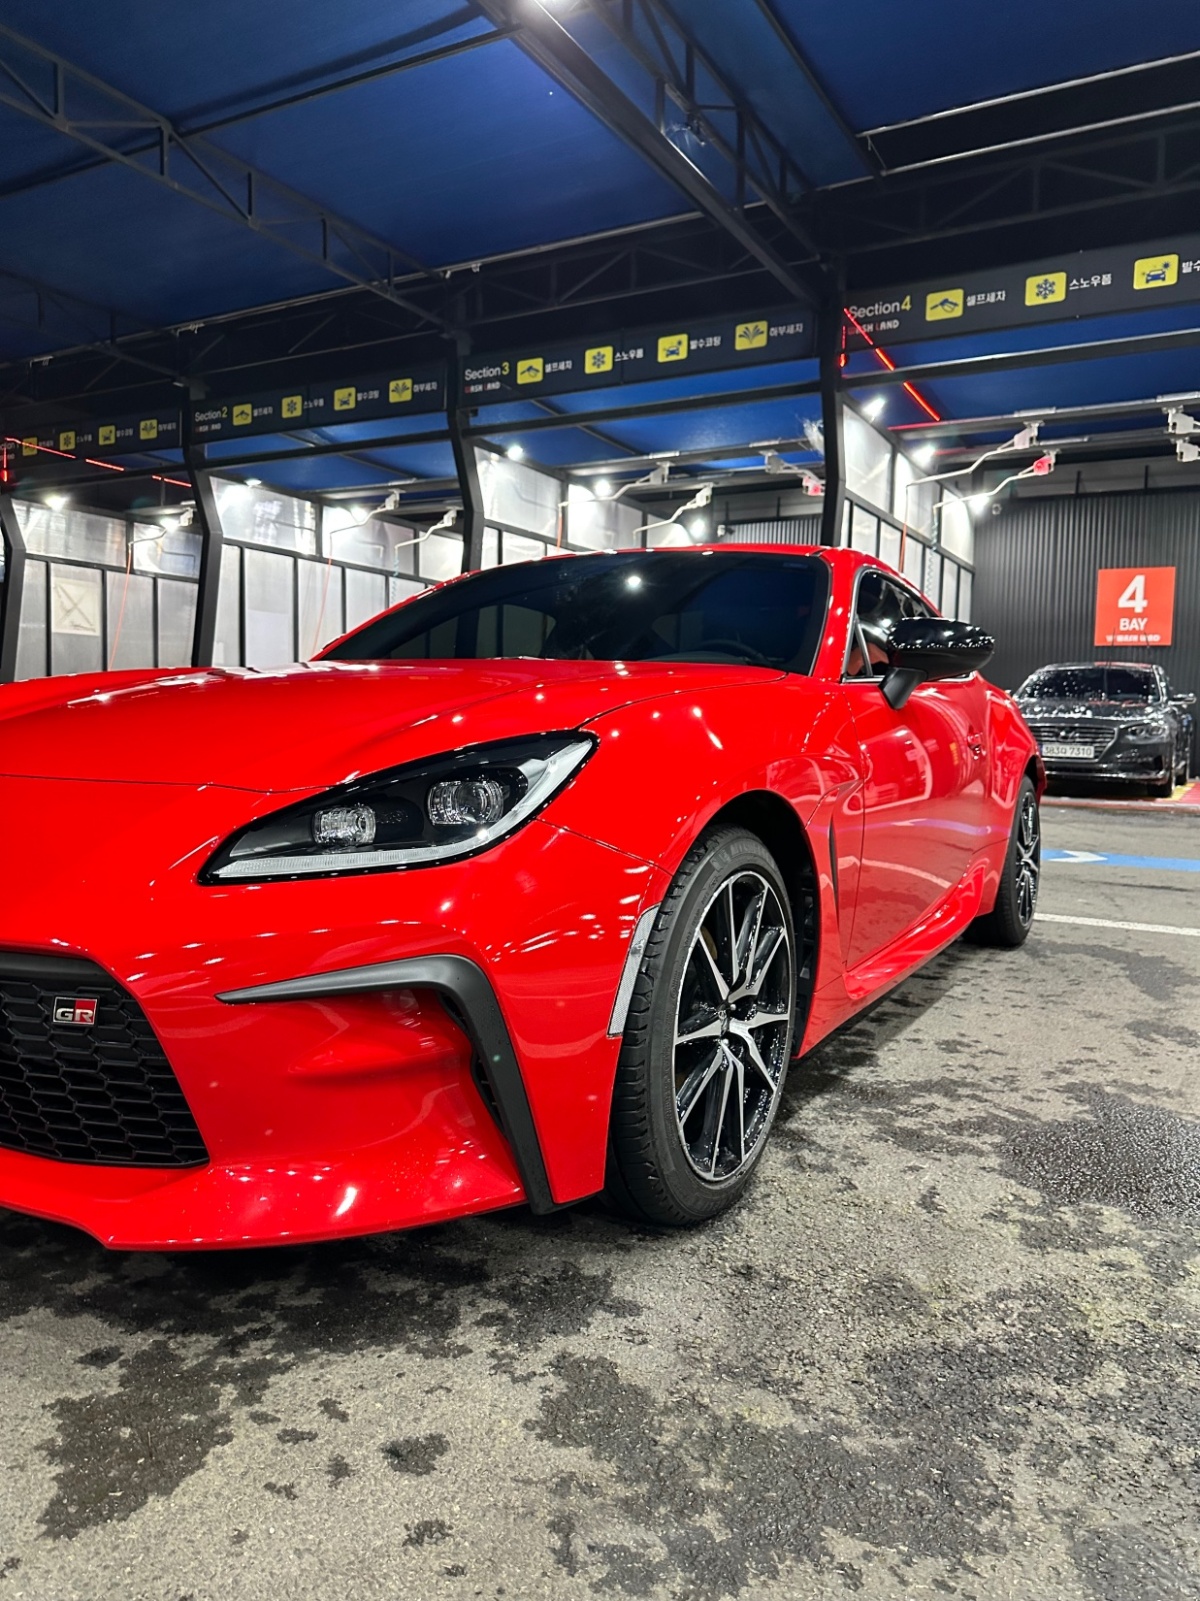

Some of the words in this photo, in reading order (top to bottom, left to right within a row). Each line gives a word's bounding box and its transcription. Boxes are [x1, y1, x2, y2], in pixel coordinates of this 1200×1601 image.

[1069, 273, 1112, 291] 스노우폼
[1117, 574, 1149, 614] 4
[1119, 617, 1148, 631] BAY
[55, 1007, 94, 1023] GR
